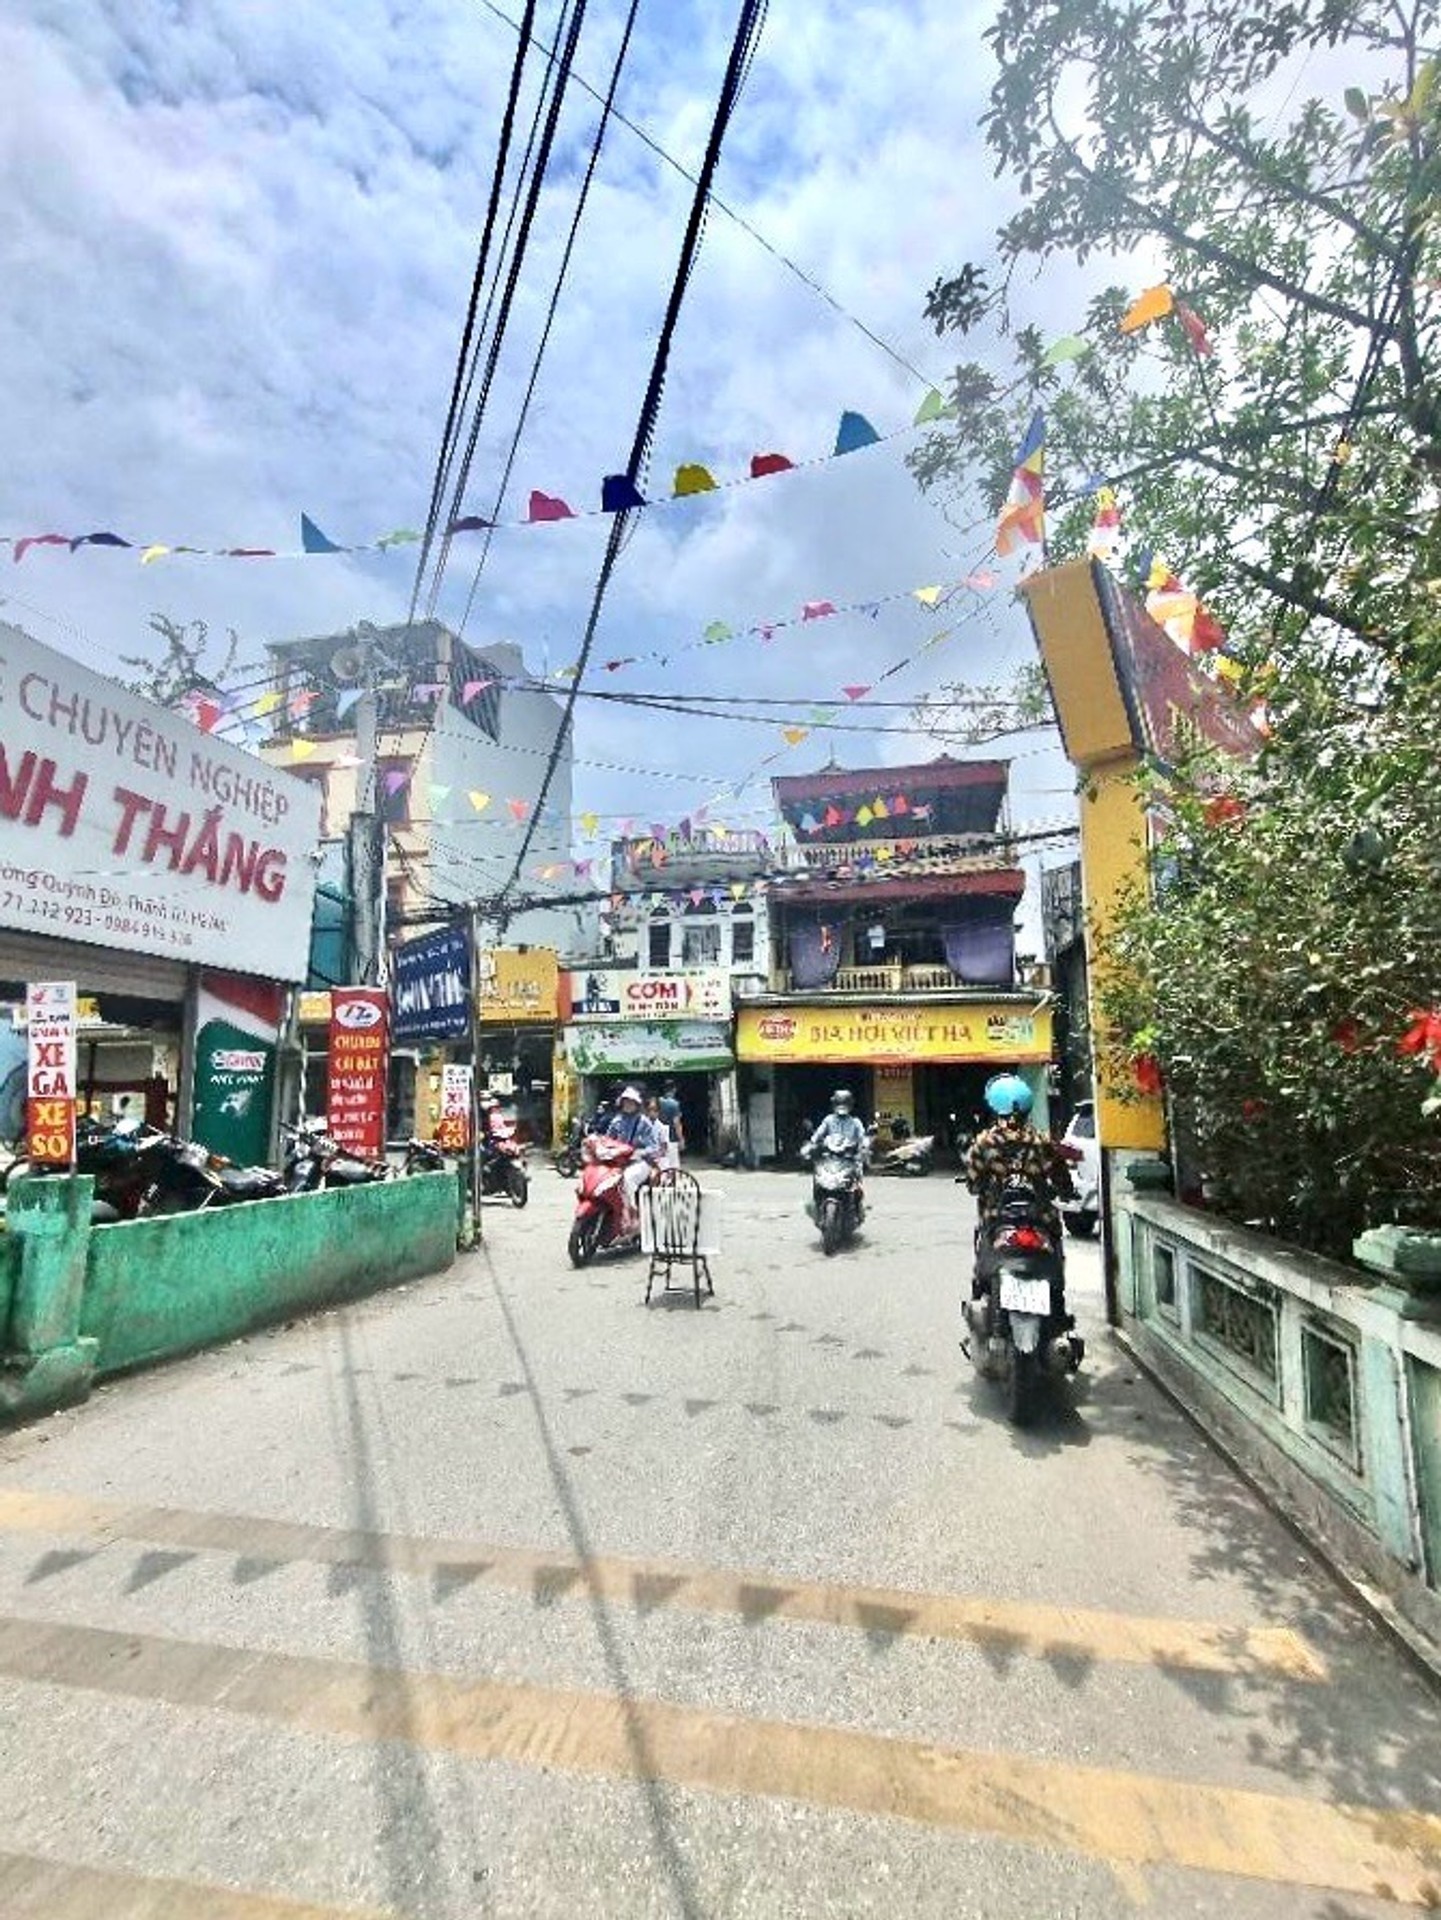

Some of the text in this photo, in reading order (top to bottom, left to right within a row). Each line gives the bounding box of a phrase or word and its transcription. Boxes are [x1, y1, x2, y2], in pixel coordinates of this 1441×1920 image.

[19, 671, 178, 779] CHUYÊN
[190, 752, 290, 830] NGHIỆP
[626, 980, 678, 999] CƠM
[35, 1042, 66, 1067] XE
[32, 1071, 68, 1096] GA
[34, 1102, 68, 1126] XE
